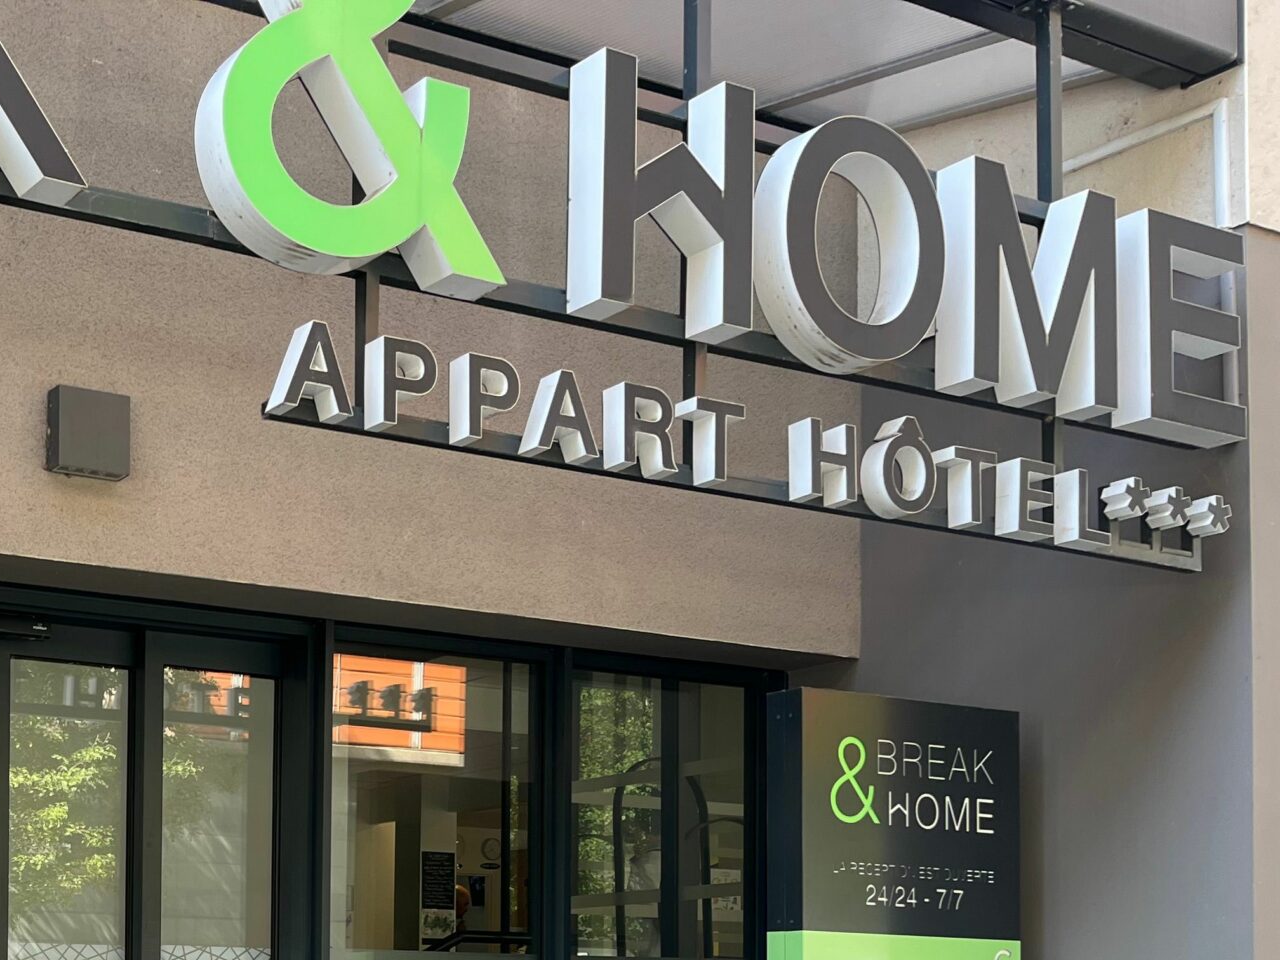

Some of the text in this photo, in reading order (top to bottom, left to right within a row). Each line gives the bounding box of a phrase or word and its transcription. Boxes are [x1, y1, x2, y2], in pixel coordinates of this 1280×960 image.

[567, 47, 1248, 449] HOME
[265, 319, 1114, 551] APPART HÔTEL
[830, 736, 880, 824] &
[877, 738, 994, 785] BREAK
[888, 790, 995, 835] HOME
